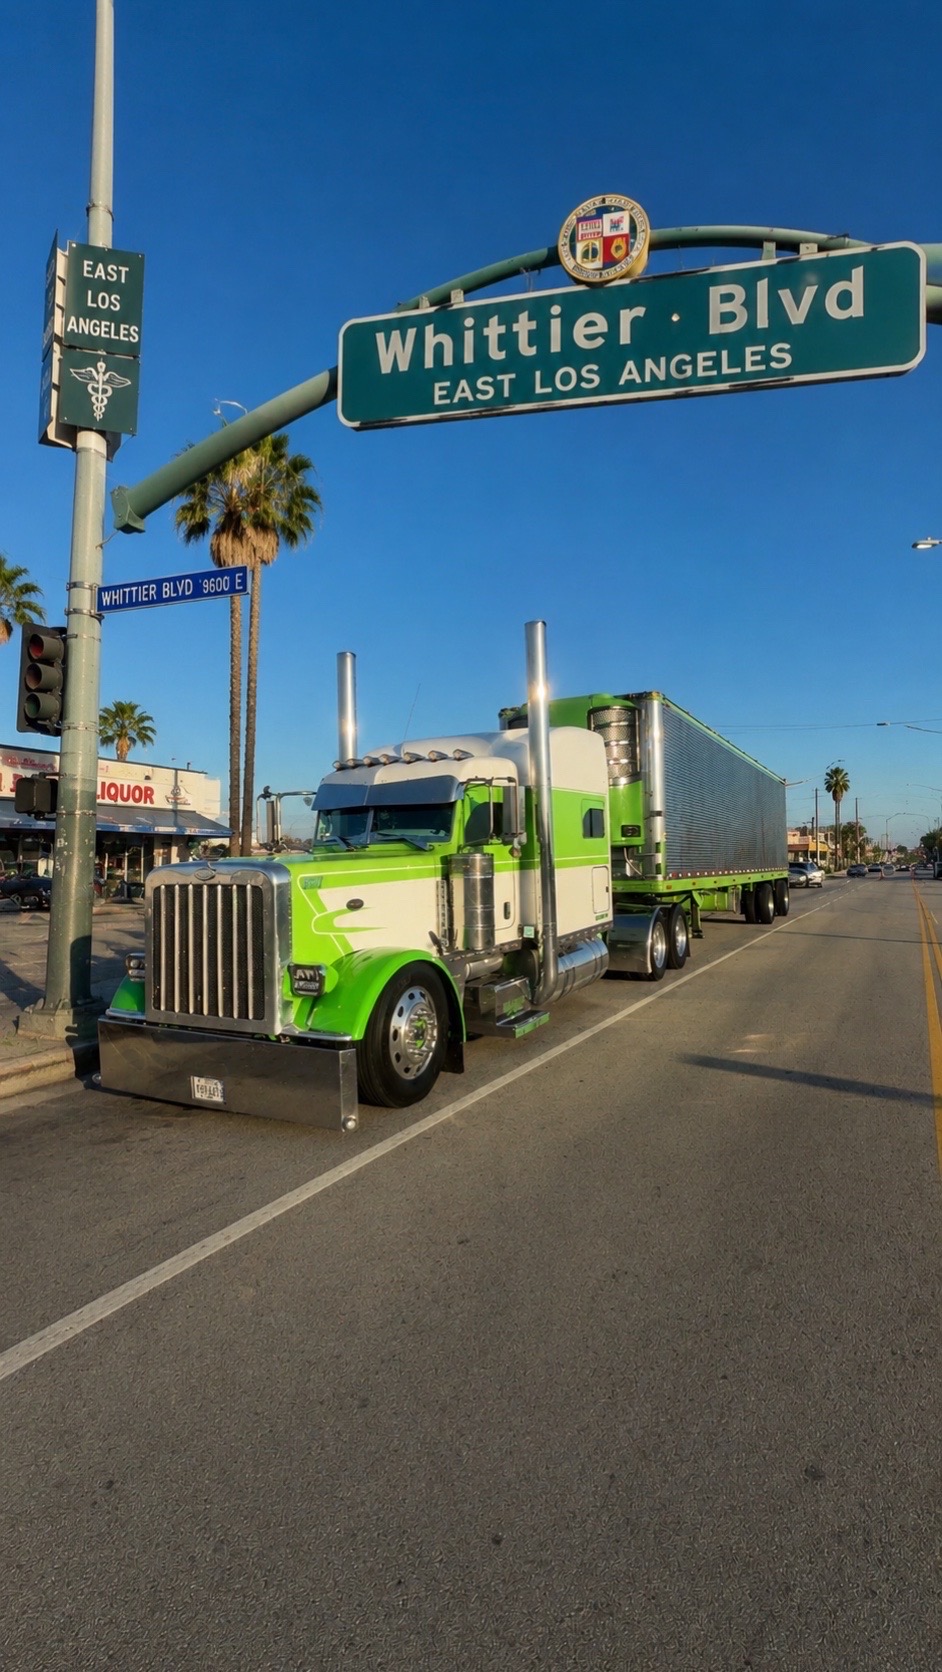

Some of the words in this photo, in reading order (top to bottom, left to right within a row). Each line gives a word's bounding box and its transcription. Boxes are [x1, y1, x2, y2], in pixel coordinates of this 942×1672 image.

[83, 260, 129, 283] EAST
[87, 290, 121, 311] LOS
[67, 316, 139, 343] ANGELES
[375, 304, 646, 375] Whittier
[708, 265, 864, 335] Blvd
[433, 373, 516, 405] EAST
[534, 364, 601, 395] LOS
[619, 343, 793, 386] ANGELES
[102, 584, 157, 606] WHITTIER
[203, 576, 230, 594] 9600
[235, 573, 243, 590] E
[97, 781, 155, 805] IQUOR
